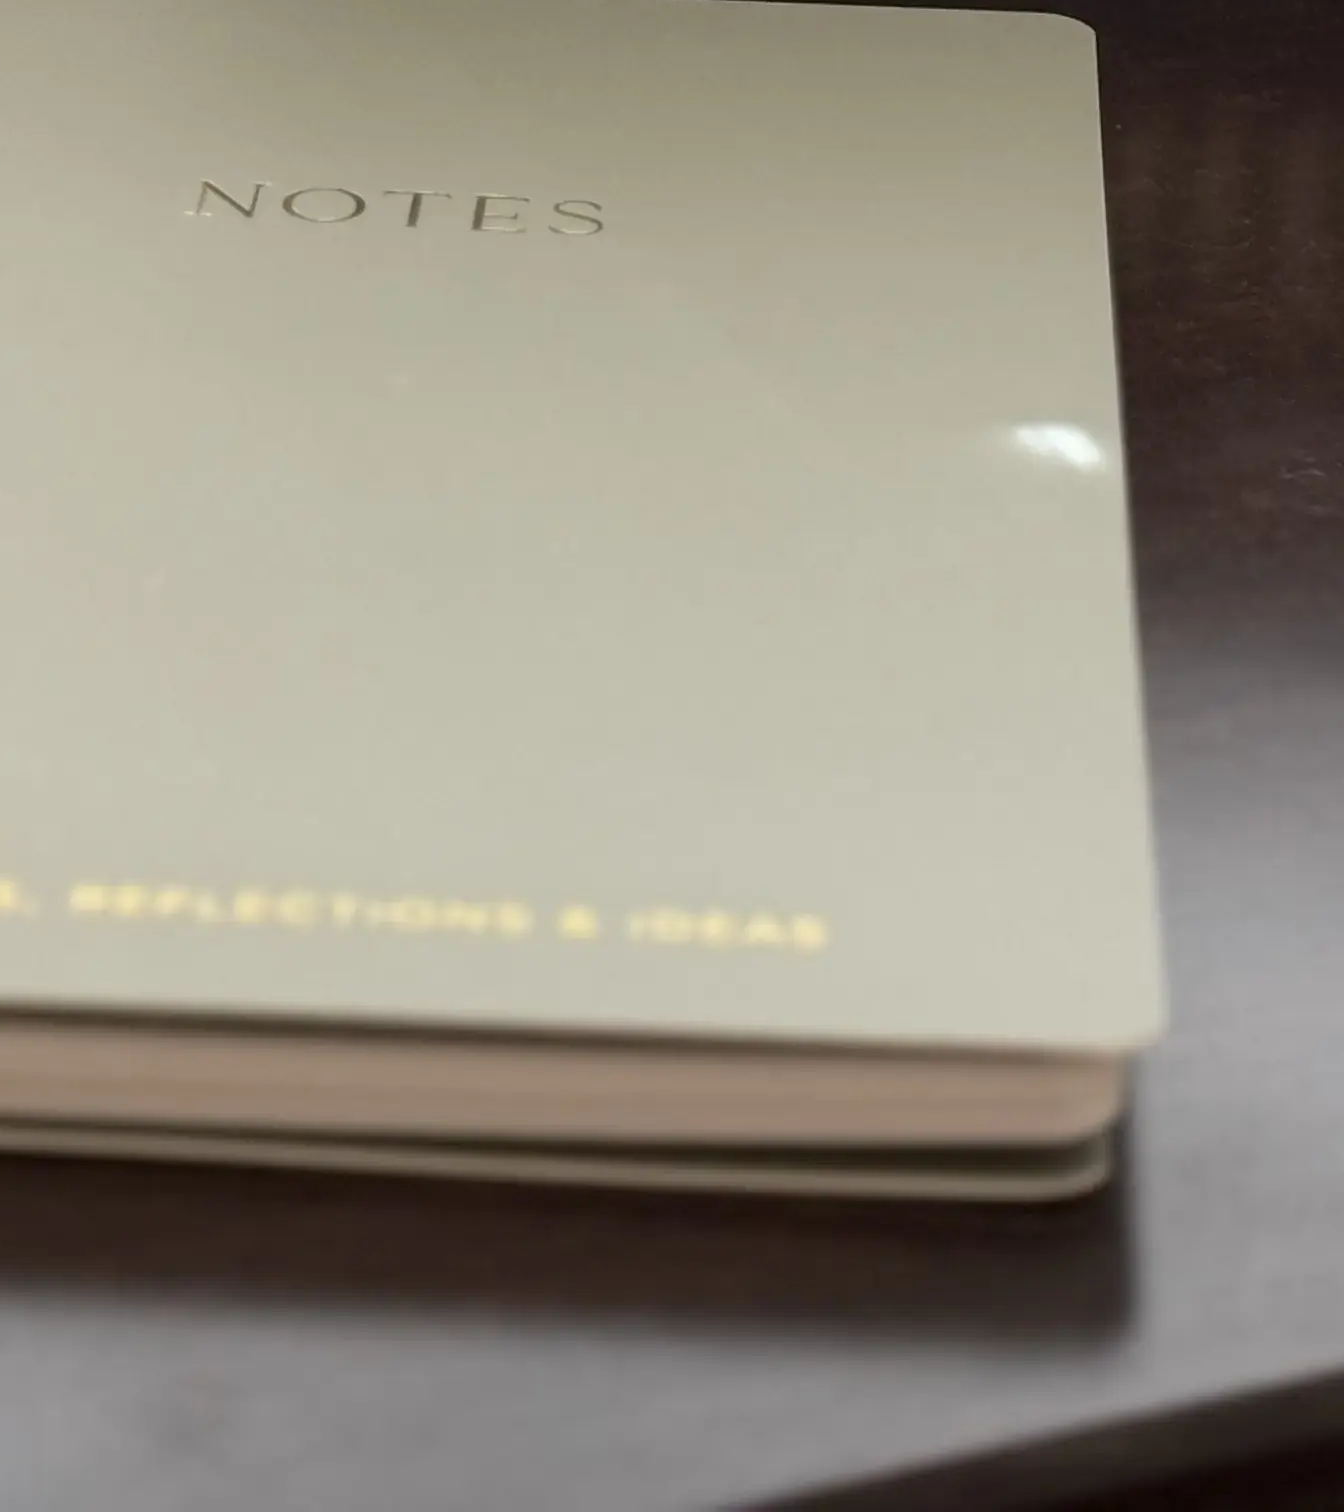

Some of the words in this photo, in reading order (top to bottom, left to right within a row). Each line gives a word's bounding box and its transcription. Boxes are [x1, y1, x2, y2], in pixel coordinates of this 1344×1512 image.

[184, 178, 604, 236] NOTES
[68, 882, 534, 944] REFLECTIONS
[628, 904, 830, 954] IDEAS
